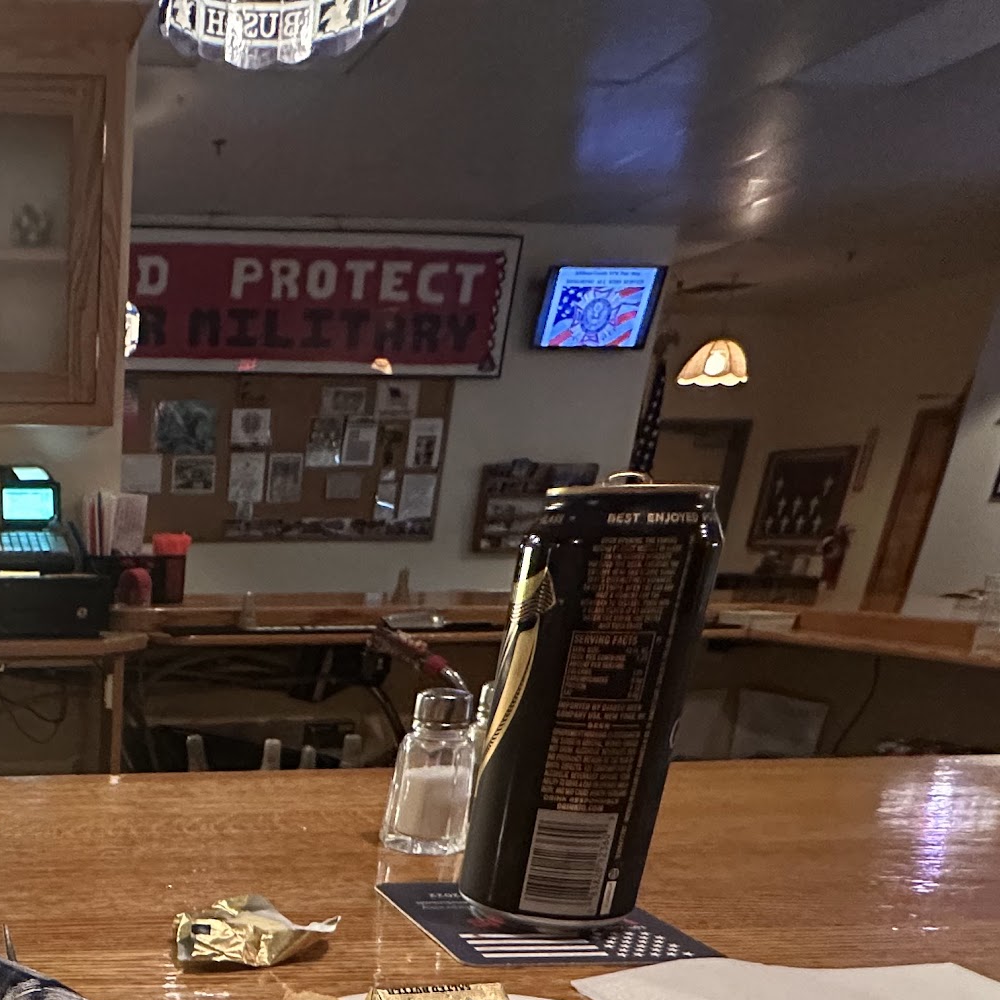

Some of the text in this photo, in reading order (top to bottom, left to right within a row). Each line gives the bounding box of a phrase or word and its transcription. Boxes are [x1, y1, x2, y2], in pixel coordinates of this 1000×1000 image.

[229, 256, 486, 306] PROTECT
[187, 305, 478, 354] MILITARY
[607, 512, 641, 525] BEST
[646, 511, 700, 525] ENJOYED
[574, 633, 638, 646] SERVING FACTS
